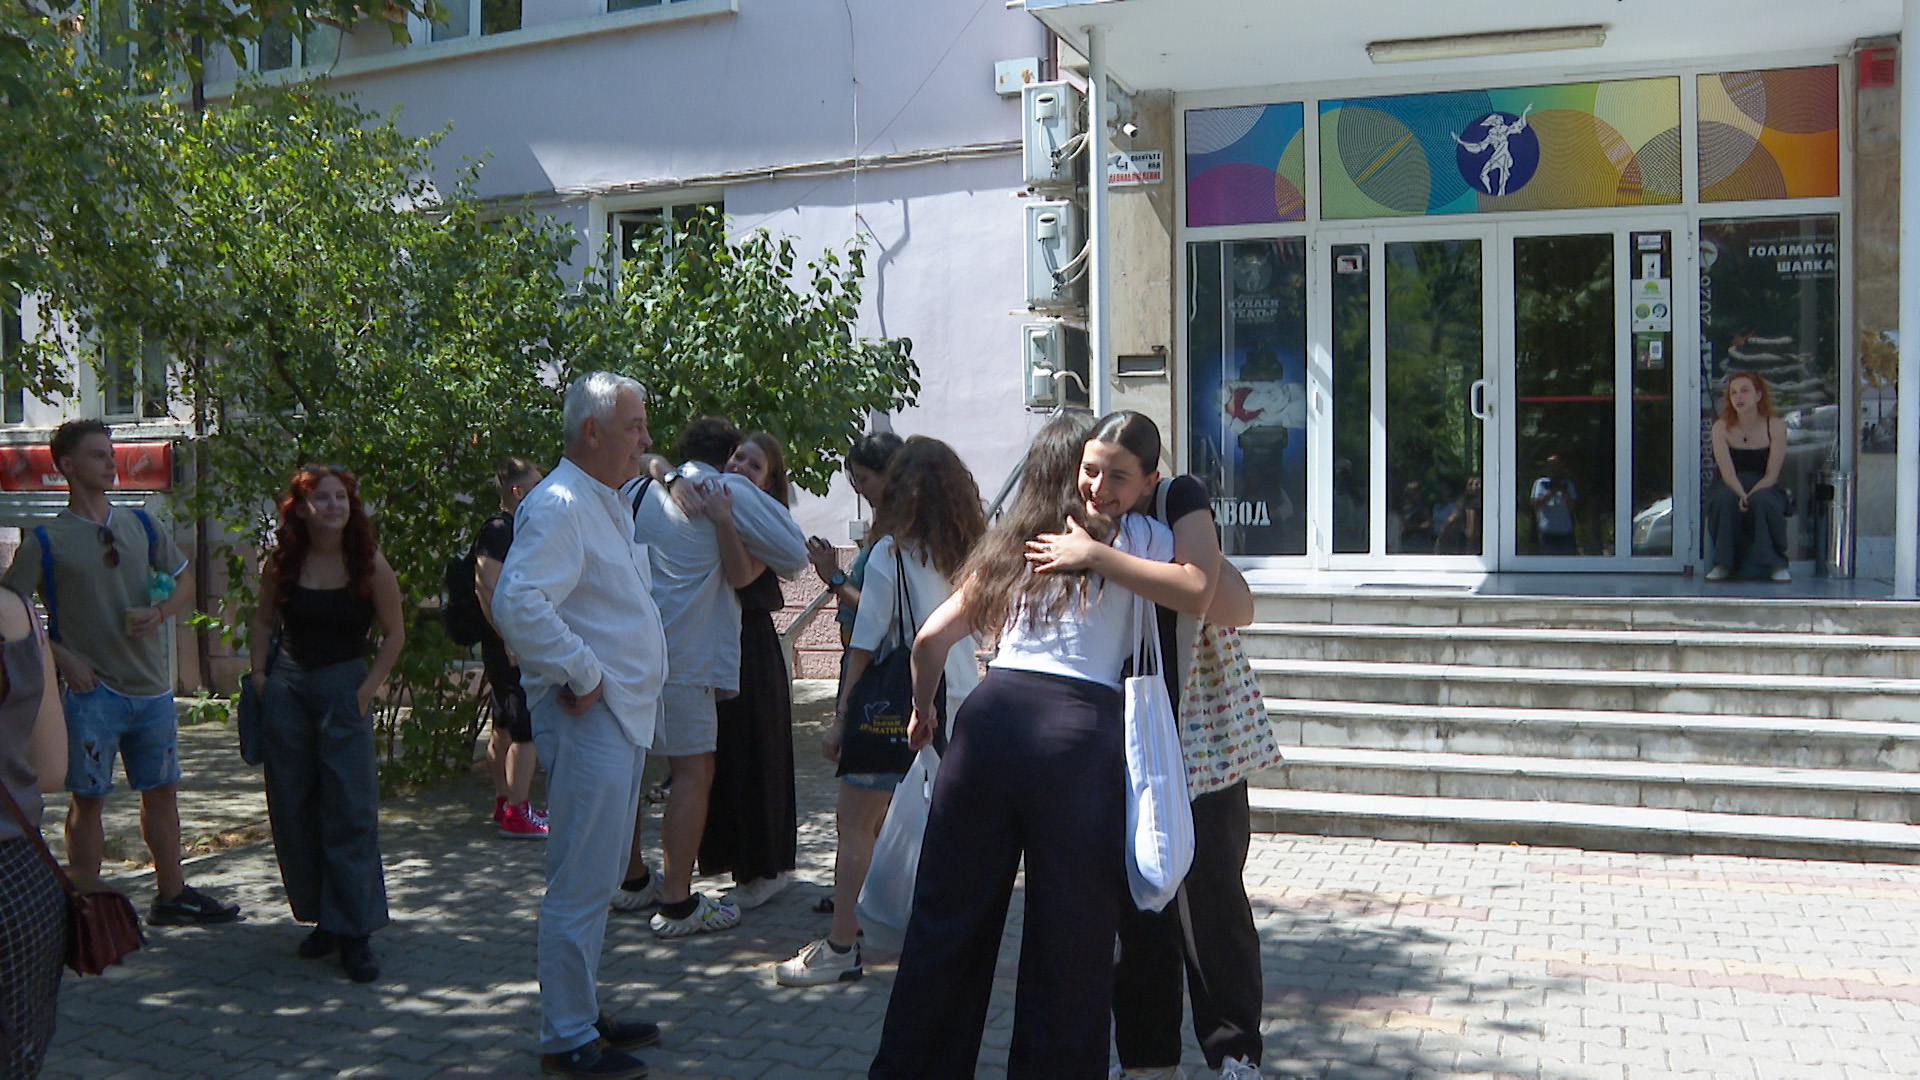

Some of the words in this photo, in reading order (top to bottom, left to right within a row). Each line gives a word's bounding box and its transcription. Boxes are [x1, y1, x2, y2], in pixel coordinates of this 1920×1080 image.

[1108, 171, 1160, 183] ДЕОНАБЛЮДЕНИЕ
[1748, 243, 1834, 257] ГОЛЯМАТА
[1777, 259, 1834, 272] ШАПКА
[1209, 501, 1270, 526] АВОД
[860, 723, 907, 734] ДРАМАТИЧ
